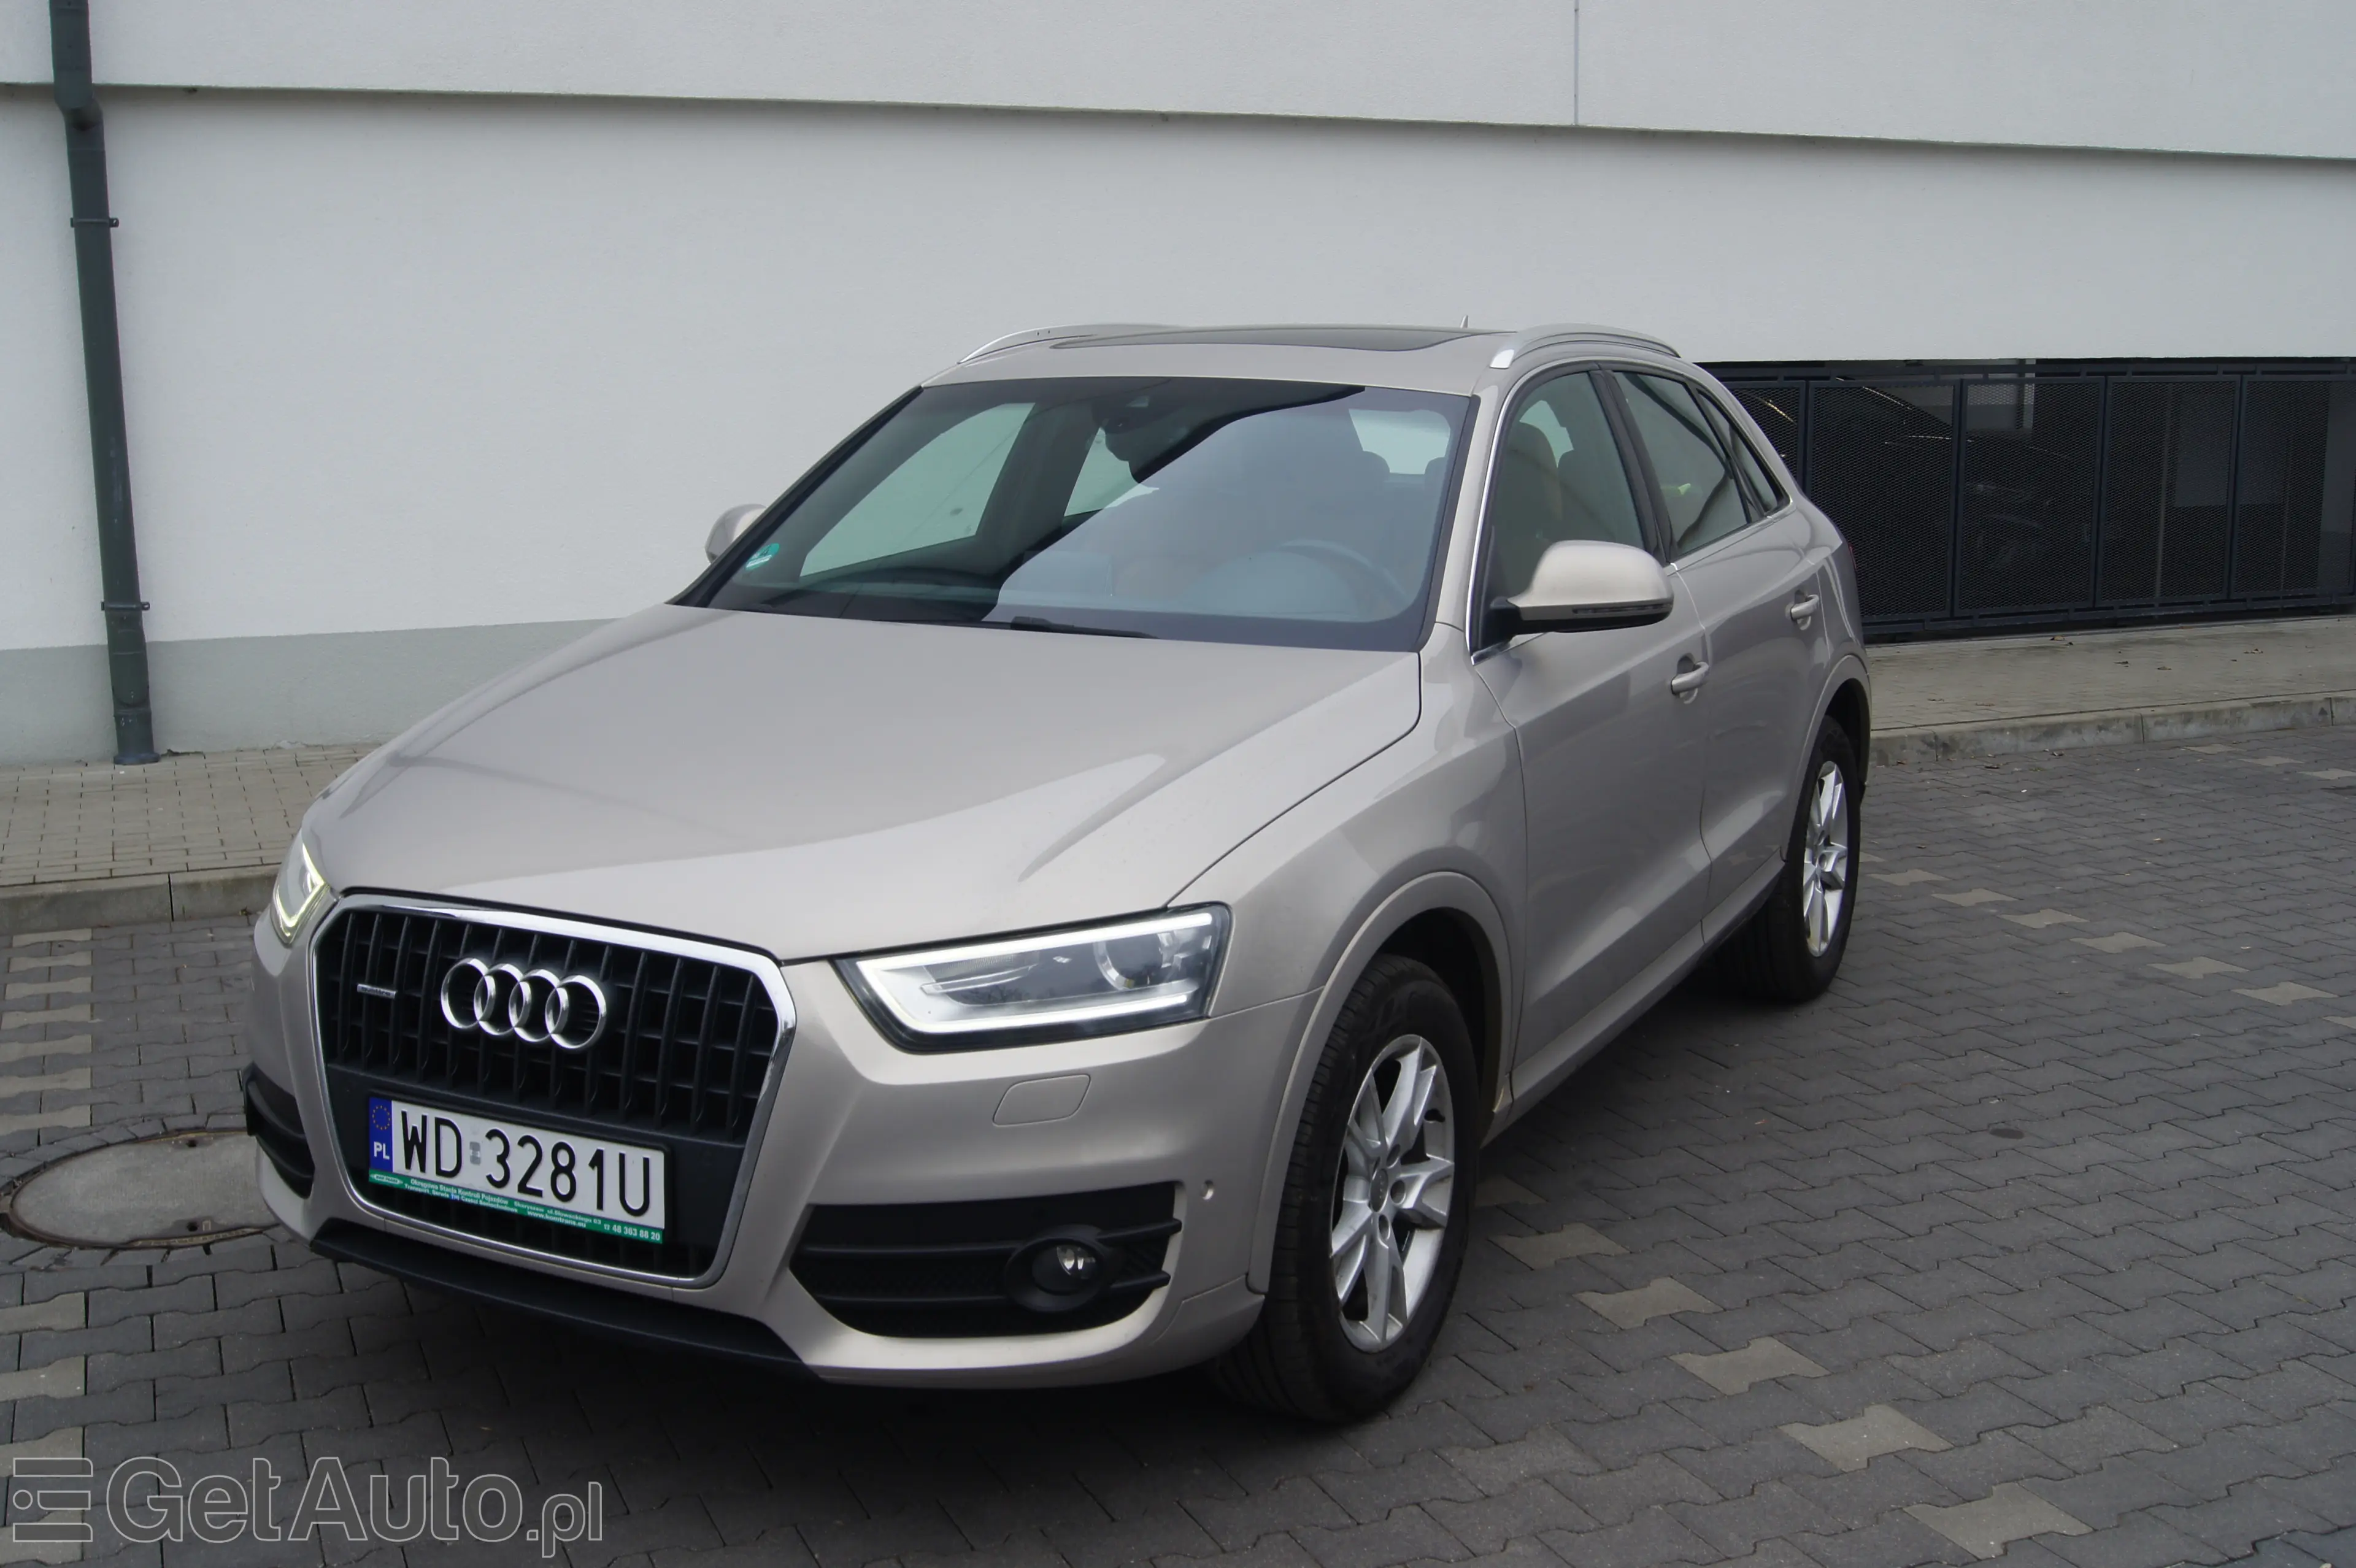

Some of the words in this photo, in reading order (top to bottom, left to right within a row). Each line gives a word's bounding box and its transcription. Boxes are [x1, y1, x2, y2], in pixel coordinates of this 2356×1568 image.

[374, 1141, 390, 1160] PL
[401, 1110, 462, 1178] WD
[485, 1128, 650, 1217] 3281U
[650, 1232, 661, 1241] 20
